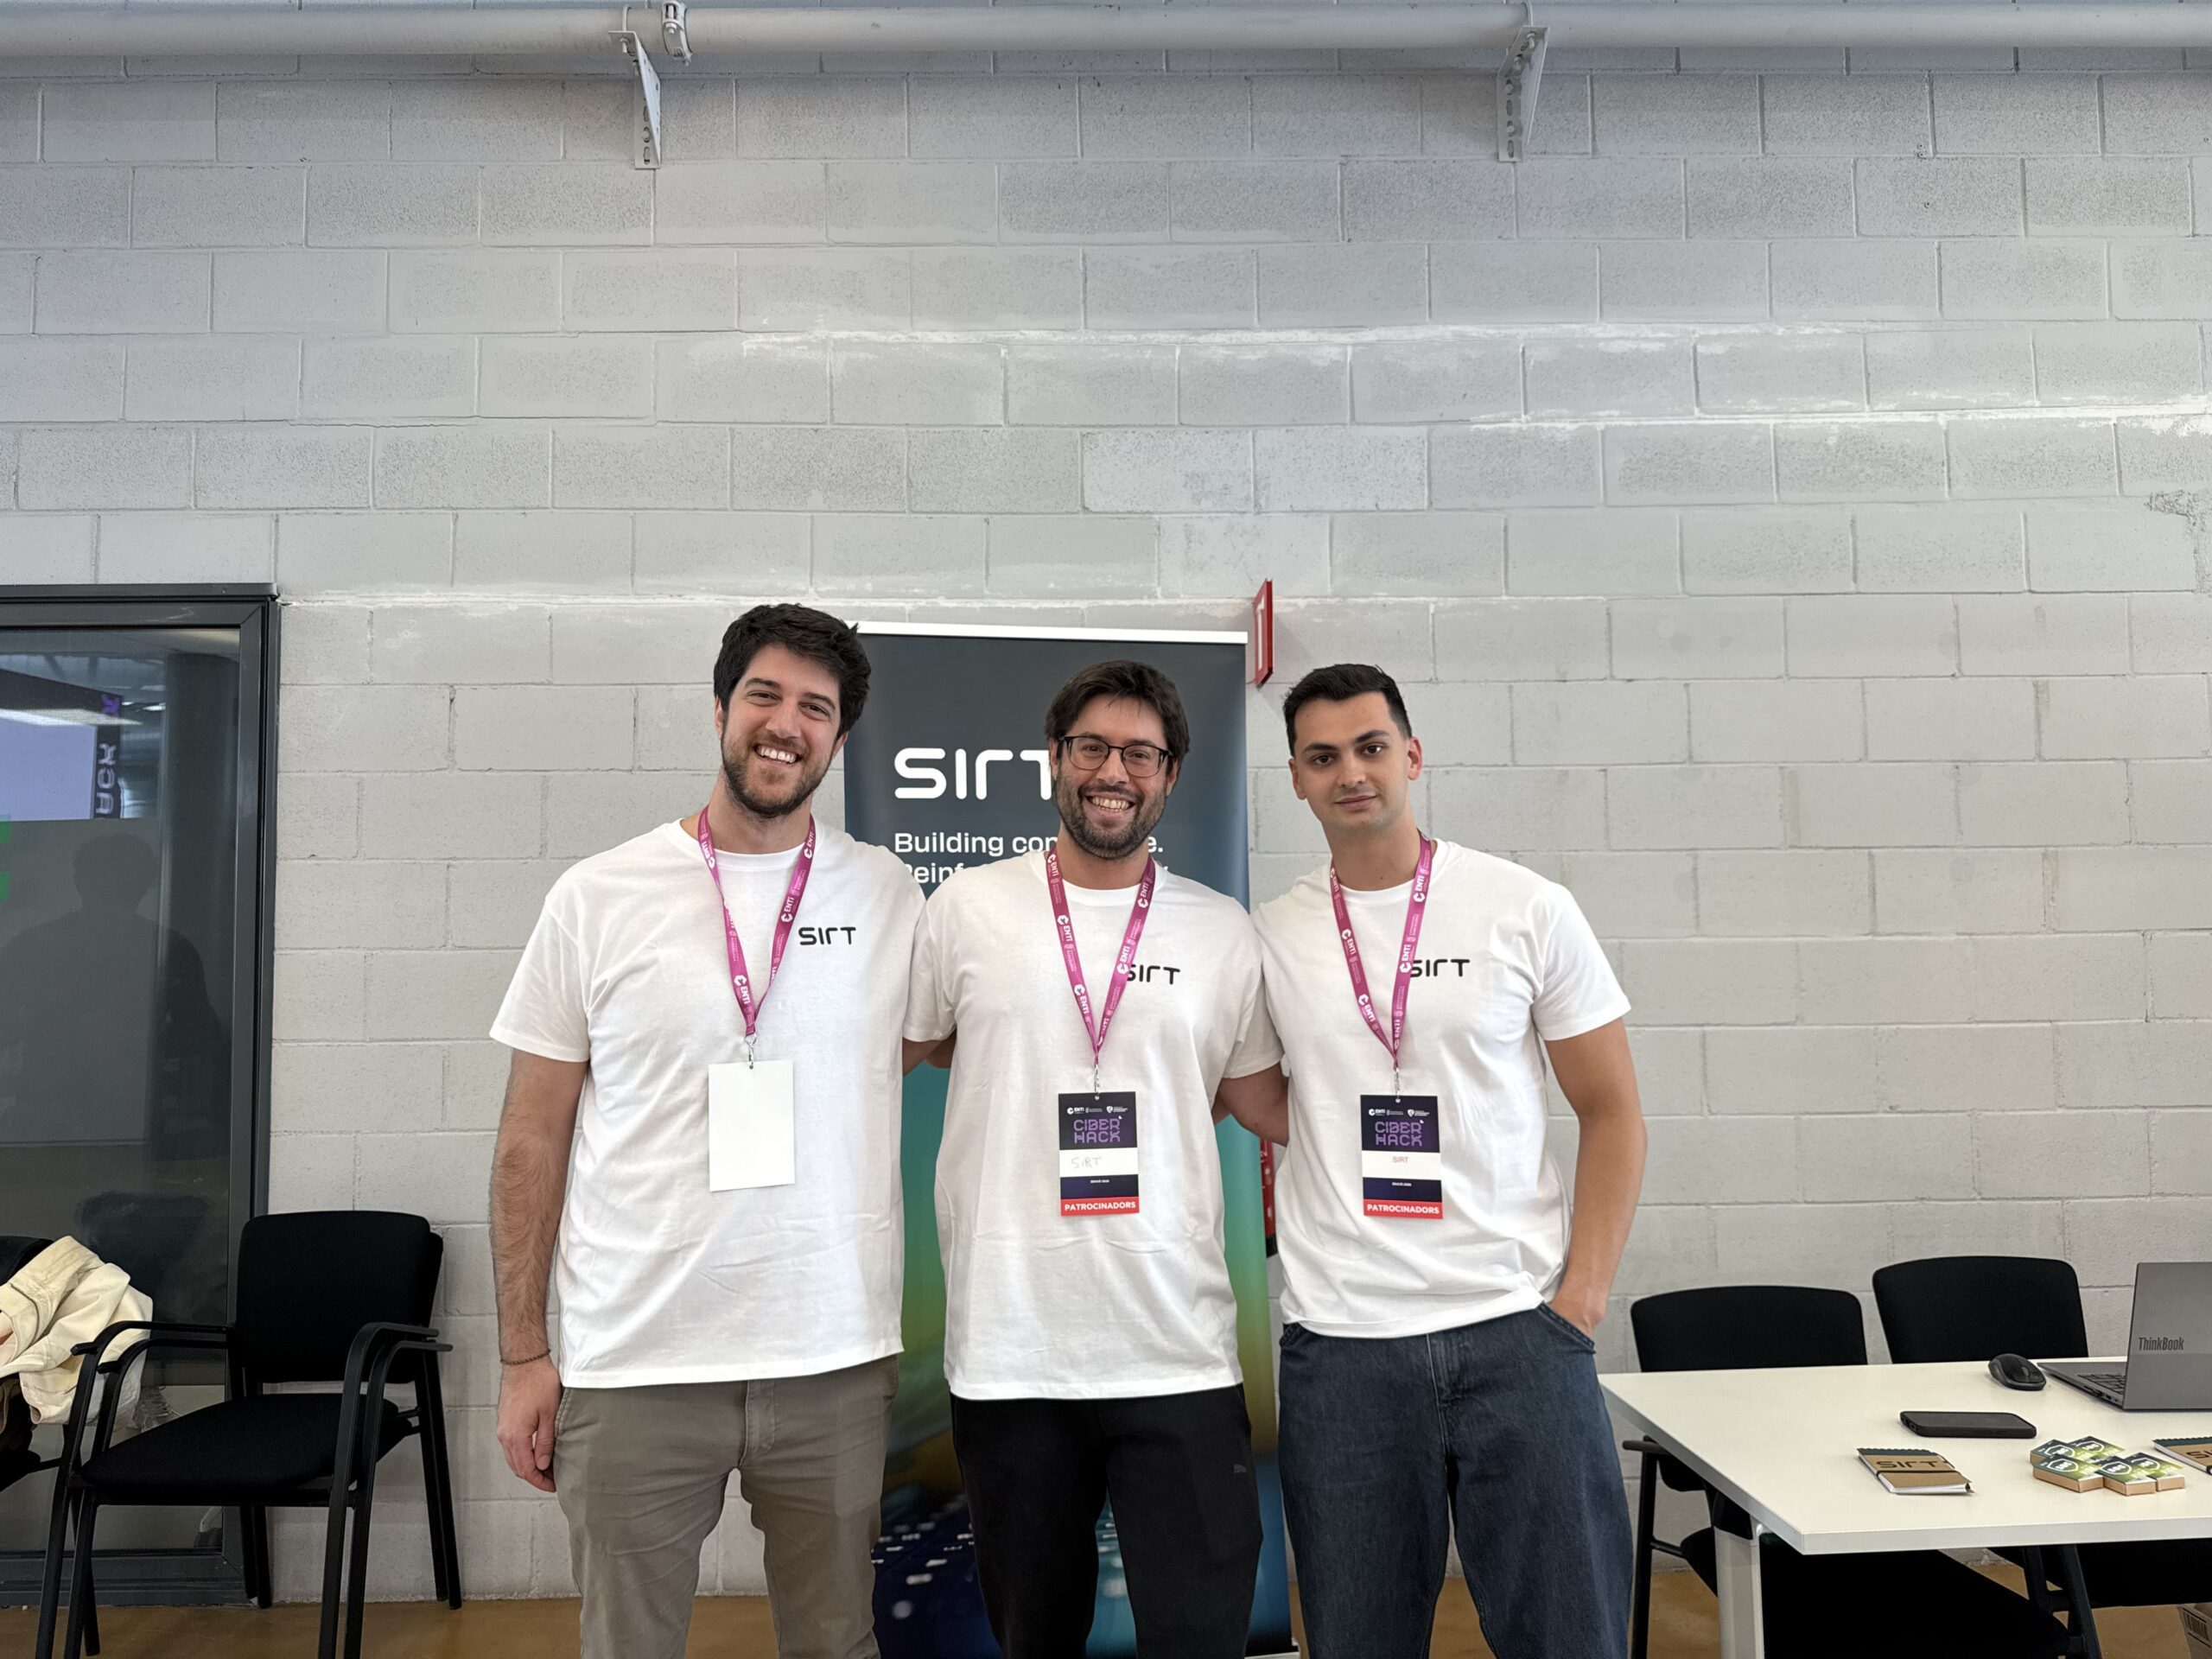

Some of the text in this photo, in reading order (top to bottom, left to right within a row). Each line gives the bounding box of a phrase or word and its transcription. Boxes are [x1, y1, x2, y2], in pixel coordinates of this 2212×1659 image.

[894, 832, 1003, 856] Building
[1140, 882, 1150, 897] ENTI
[1415, 875, 1425, 891] ENTI
[784, 896, 795, 913] ENTI
[1063, 925, 1073, 942] ENTI
[1120, 945, 1131, 964] ENTI
[1346, 938, 1357, 955] ENTI
[1402, 944, 1412, 962] ENTI
[740, 985, 751, 1005] ENTI
[1363, 1004, 1376, 1023] ENTI
[1073, 1118, 1121, 1132] CIBER
[1375, 1122, 1422, 1135] CIBER
[1074, 1131, 1121, 1144] HACK
[1376, 1134, 1423, 1147] HACK
[1065, 1201, 1136, 1211] PATROCINADORS
[1367, 1203, 1440, 1214] PATROCINADORS
[2139, 1337, 2184, 1351] ThinkBook
